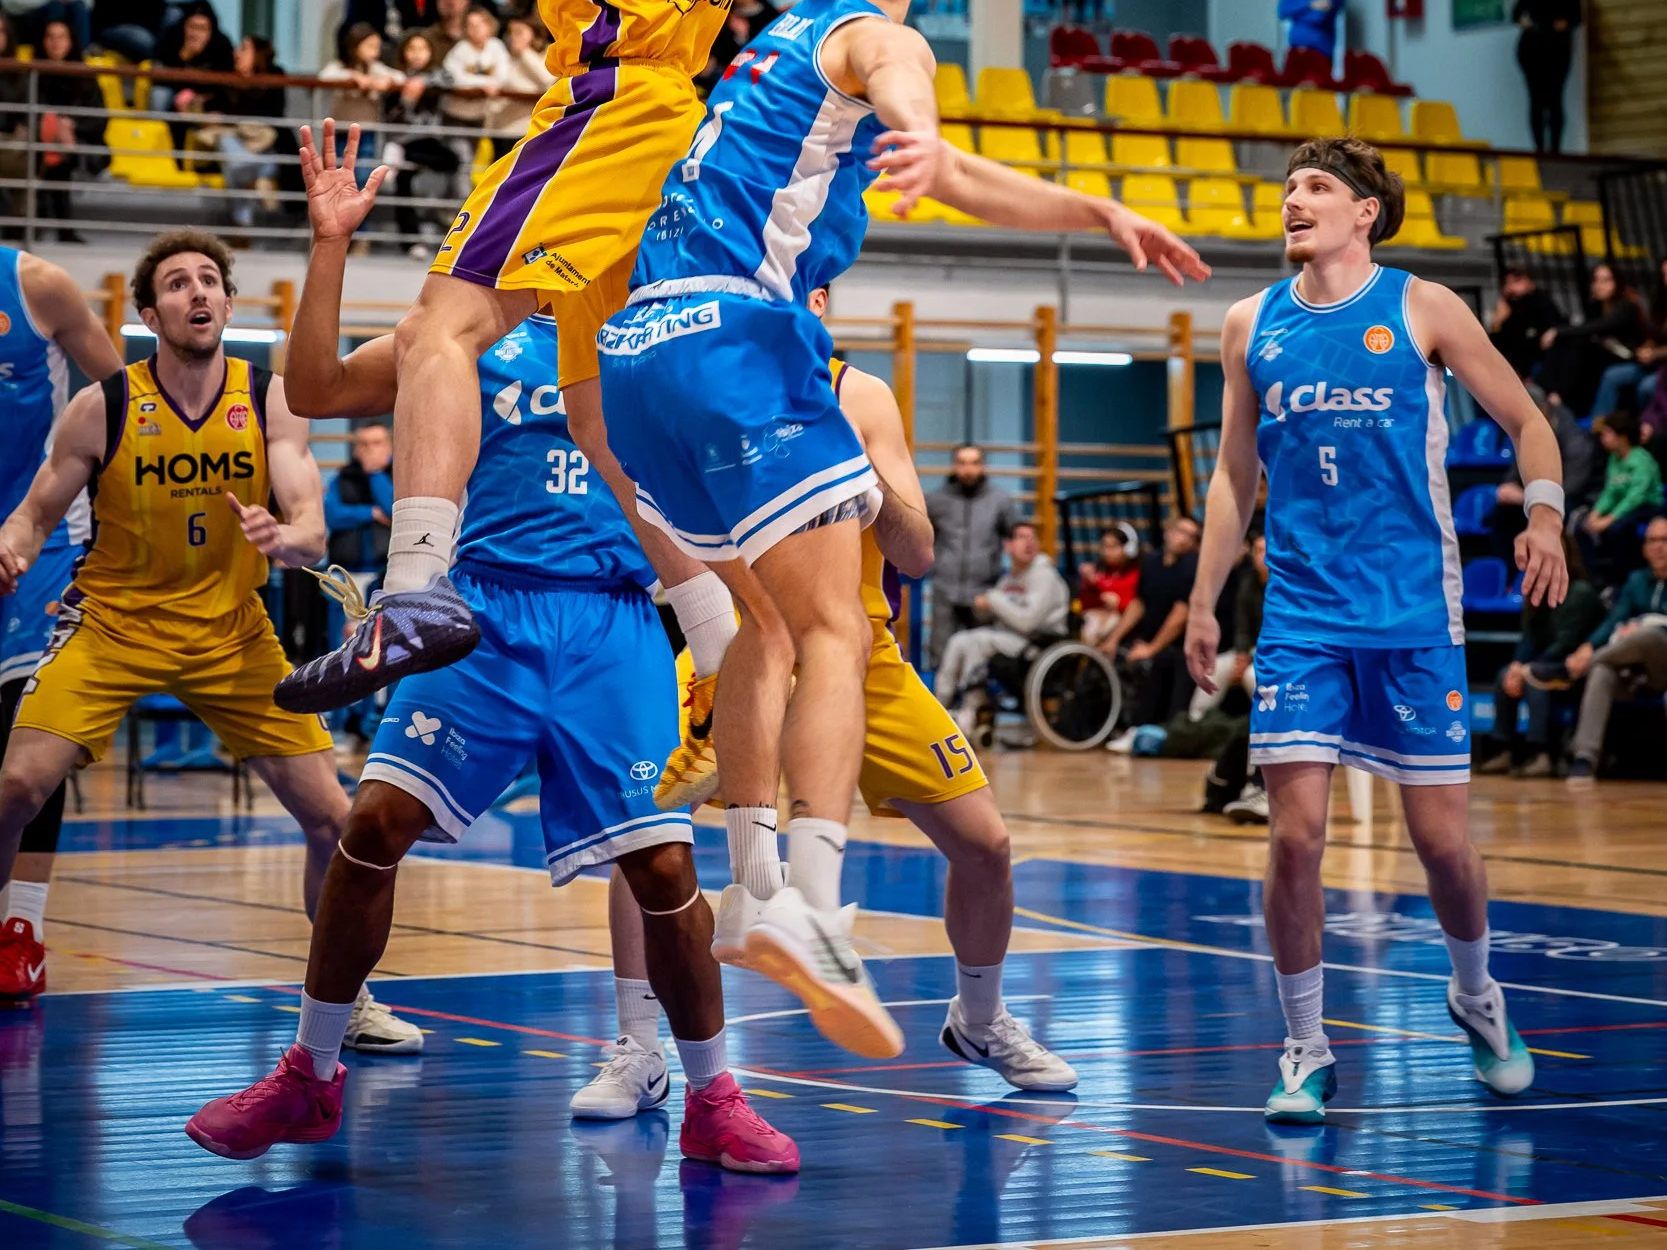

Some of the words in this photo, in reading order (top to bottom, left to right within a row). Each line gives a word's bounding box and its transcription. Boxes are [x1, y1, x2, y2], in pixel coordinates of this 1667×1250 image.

[545, 260, 556, 269] de
[551, 252, 591, 286] Ajuntament
[1289, 381, 1394, 412] Class
[1333, 416, 1361, 428] Rent
[1365, 417, 1374, 428] a
[135, 451, 255, 486] HOMS
[545, 449, 589, 495] 32
[1318, 446, 1339, 487] 5
[170, 486, 222, 499] RENTALS
[187, 512, 207, 547] 6
[929, 734, 974, 779] 15
